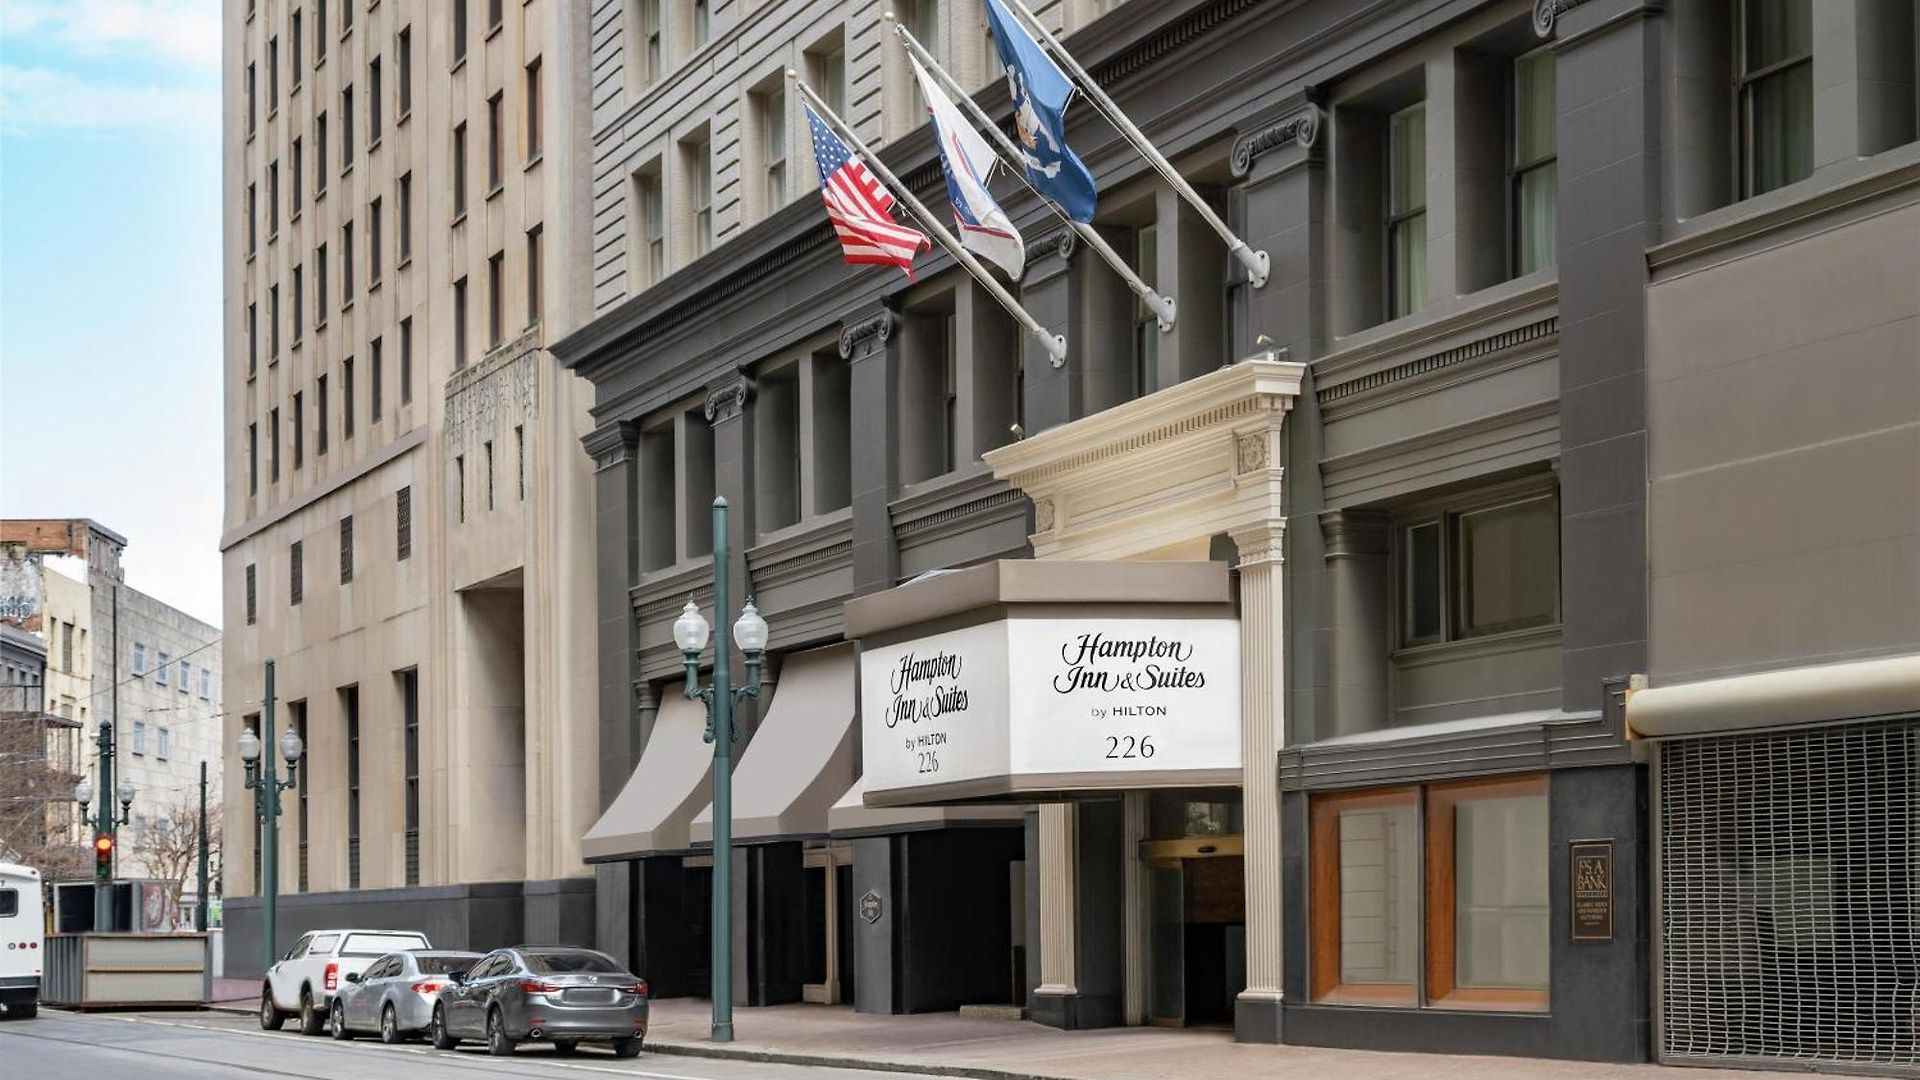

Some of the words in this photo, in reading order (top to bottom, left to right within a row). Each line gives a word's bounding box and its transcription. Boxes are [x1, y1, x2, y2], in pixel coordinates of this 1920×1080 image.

[1062, 633, 1193, 666] Hampton
[890, 650, 962, 696] Hampton
[1053, 666, 1120, 694] Inn
[1121, 672, 1136, 692] &
[1136, 665, 1206, 691] Suites
[886, 695, 922, 729] Inn
[922, 700, 933, 721] &
[931, 685, 969, 717] Suites
[1091, 706, 1107, 720] by
[1112, 705, 1168, 717] HILTON
[905, 736, 915, 750] by
[918, 731, 947, 747] HILTON
[1105, 735, 1156, 760] 226
[918, 750, 940, 774] 226
[1577, 874, 1607, 890] BANK
